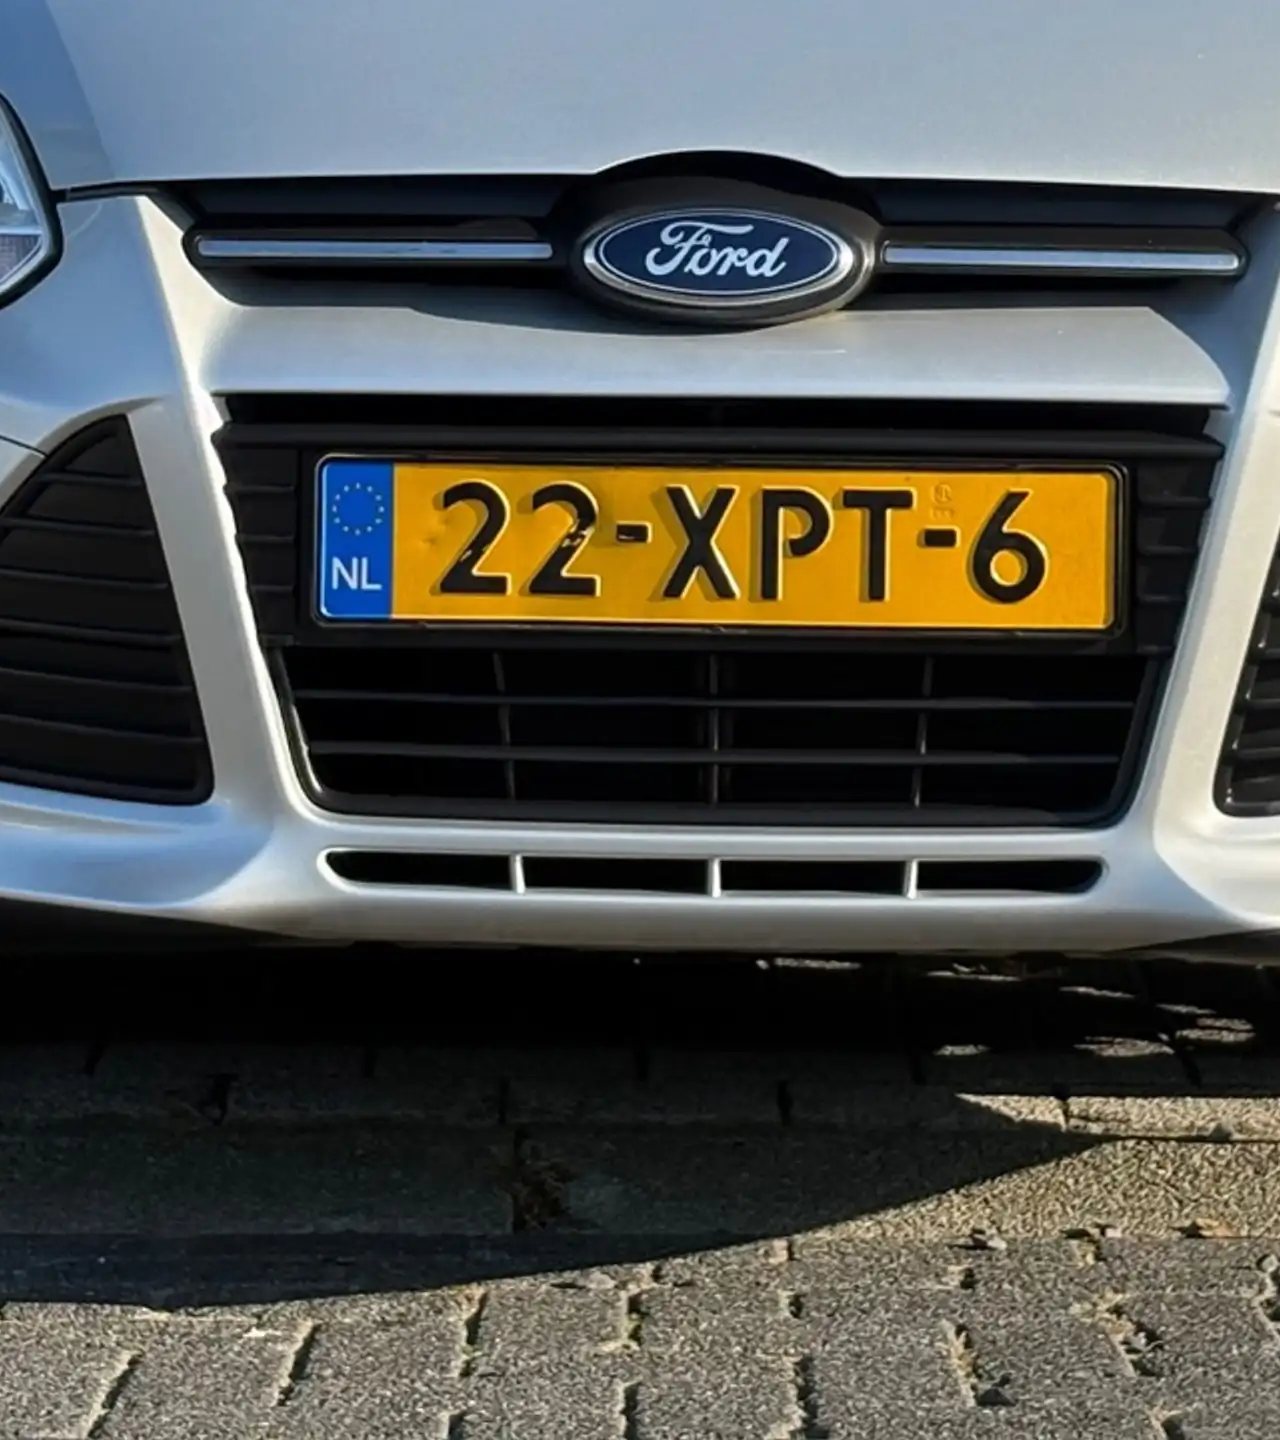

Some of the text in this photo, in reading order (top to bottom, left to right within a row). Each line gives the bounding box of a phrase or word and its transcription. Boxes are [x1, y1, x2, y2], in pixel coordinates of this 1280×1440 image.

[645, 220, 790, 278] Ford
[437, 478, 1049, 604] 22-XPT-6
[331, 556, 382, 591] NL
